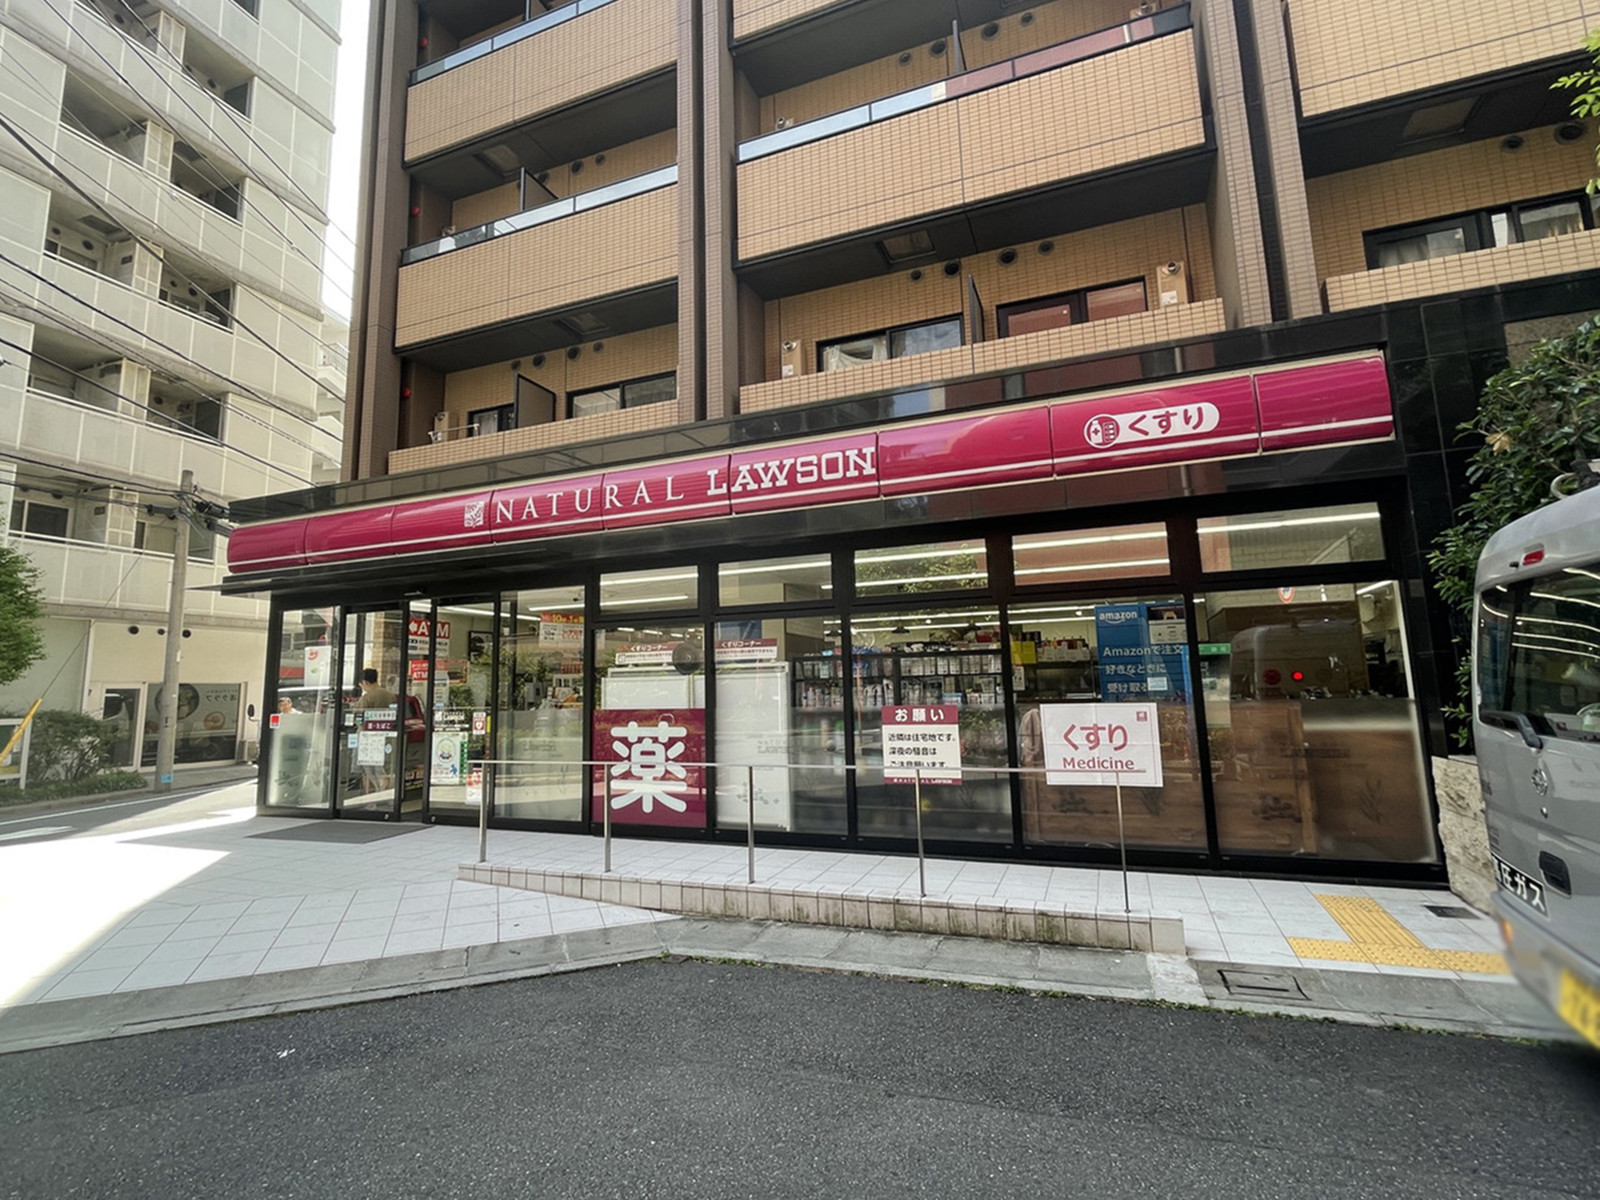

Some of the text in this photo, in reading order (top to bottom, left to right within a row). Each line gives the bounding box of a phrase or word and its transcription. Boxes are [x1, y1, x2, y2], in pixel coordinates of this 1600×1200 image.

[1128, 406, 1204, 436] くすり
[496, 446, 877, 524] NATURAL LAWSON
[1099, 606, 1138, 620] amazon
[417, 621, 449, 638] AM
[1103, 644, 1184, 657] Amazonで注文
[894, 707, 945, 722] お願い
[1063, 723, 1128, 751] くすり
[610, 721, 688, 814] 薬
[1063, 757, 1135, 770] Medicine
